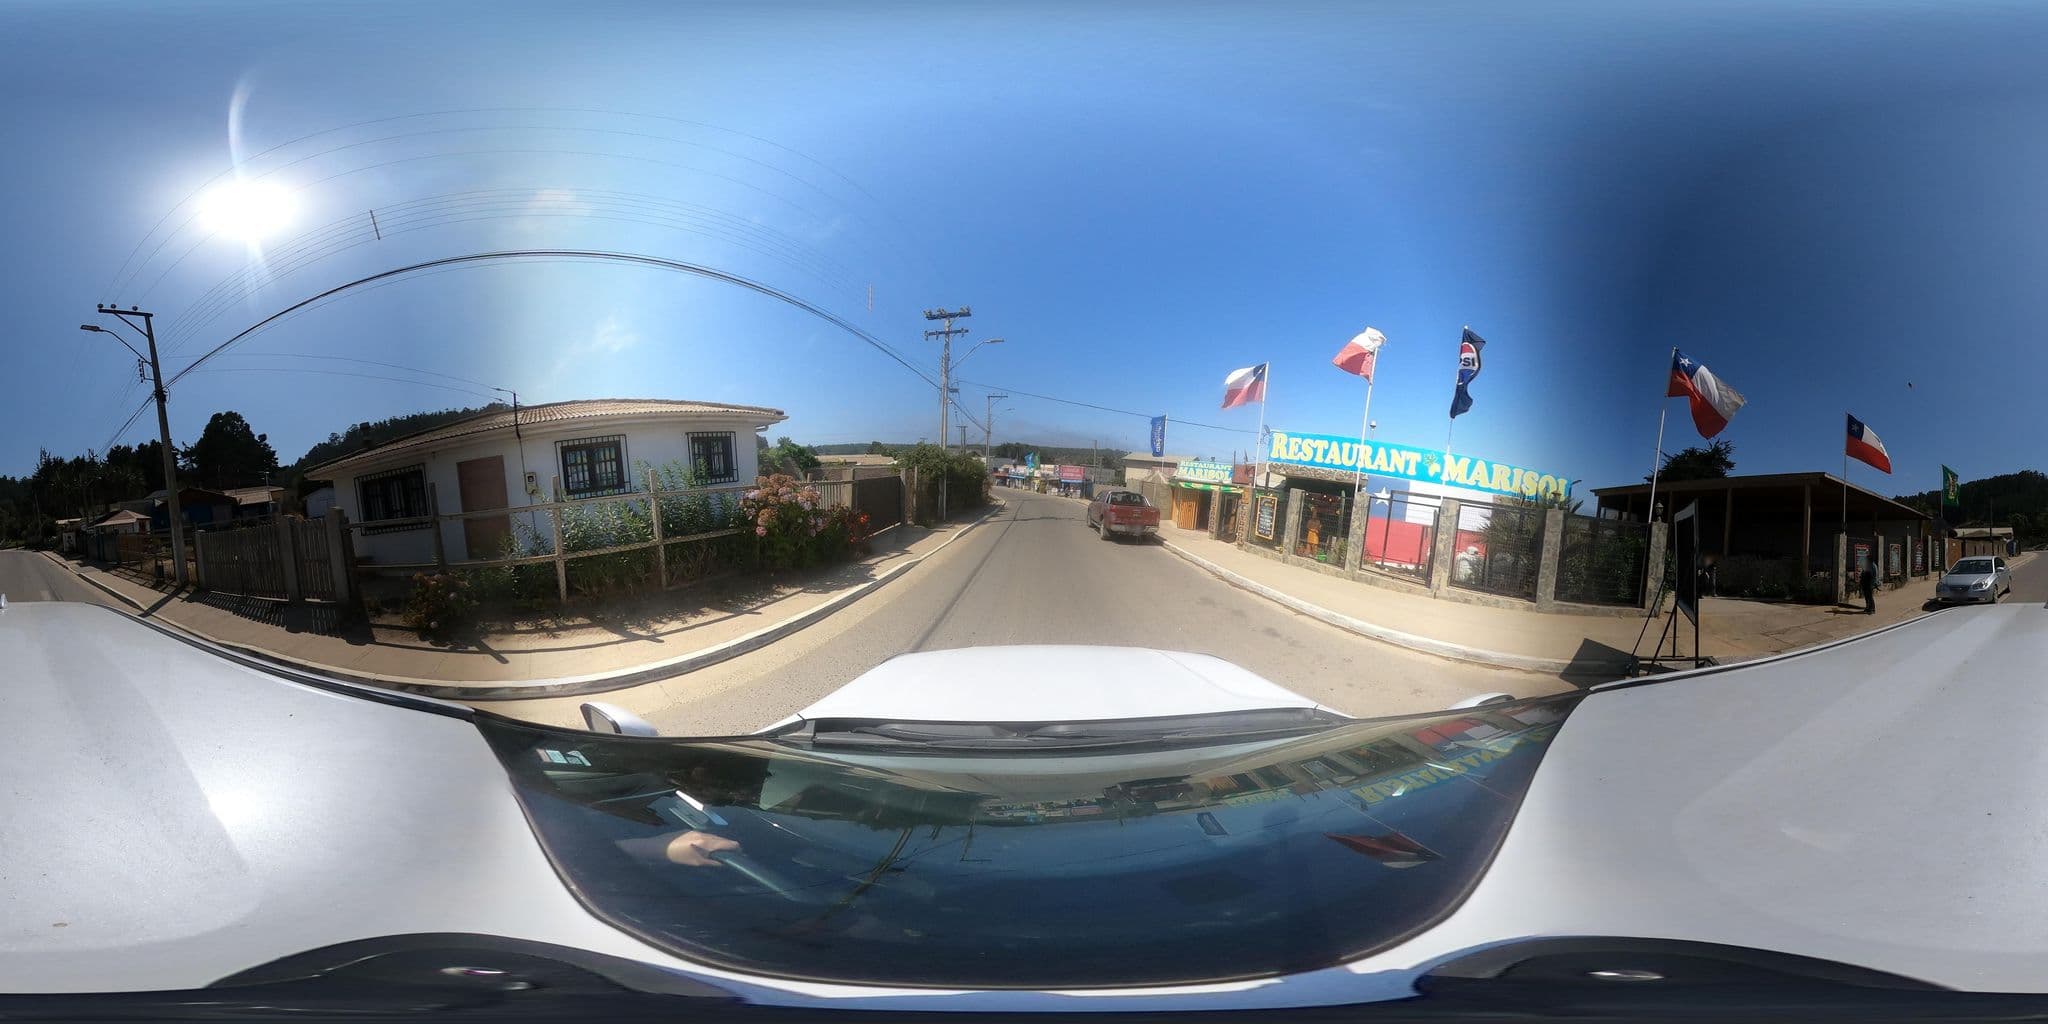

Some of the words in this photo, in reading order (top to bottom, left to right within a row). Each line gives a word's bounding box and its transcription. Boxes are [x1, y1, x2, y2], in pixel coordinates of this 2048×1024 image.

[1270, 432, 1422, 475] RESTAURANT
[1180, 460, 1232, 470] RESTAURANT
[1178, 466, 1230, 481] MARISOL
